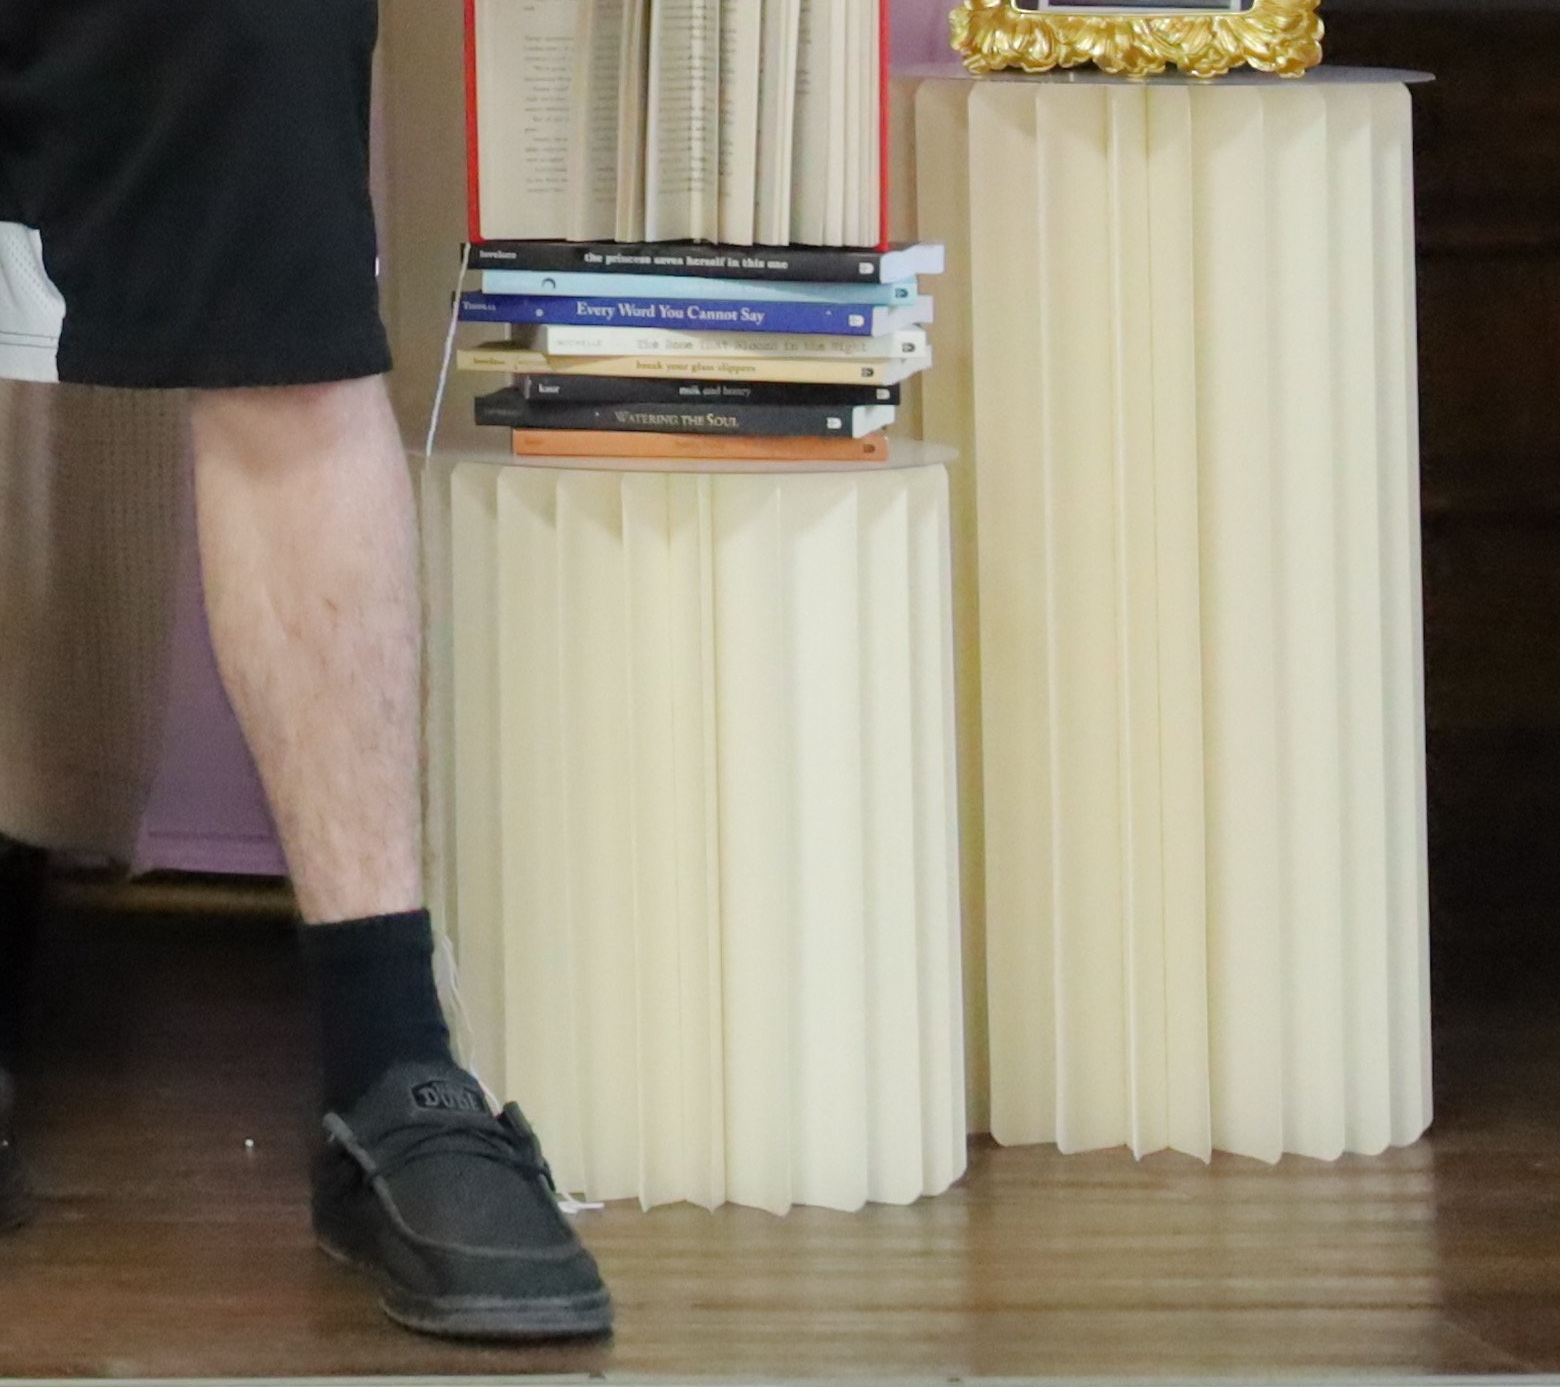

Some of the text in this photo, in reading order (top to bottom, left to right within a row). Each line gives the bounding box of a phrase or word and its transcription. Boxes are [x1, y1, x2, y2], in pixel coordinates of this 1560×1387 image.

[583, 252, 603, 263] the
[605, 254, 651, 265] princess
[685, 256, 726, 267] herself
[727, 257, 740, 268] in
[742, 258, 765, 269] this
[767, 260, 789, 270] one
[576, 301, 616, 320] Every
[618, 302, 657, 317] Word
[658, 304, 684, 318] You
[687, 306, 738, 321] Cannot
[739, 307, 766, 325] Say
[635, 360, 663, 369] break
[678, 385, 701, 395] milk
[702, 385, 721, 395] and
[613, 411, 738, 427] WATERING THE SOUL
